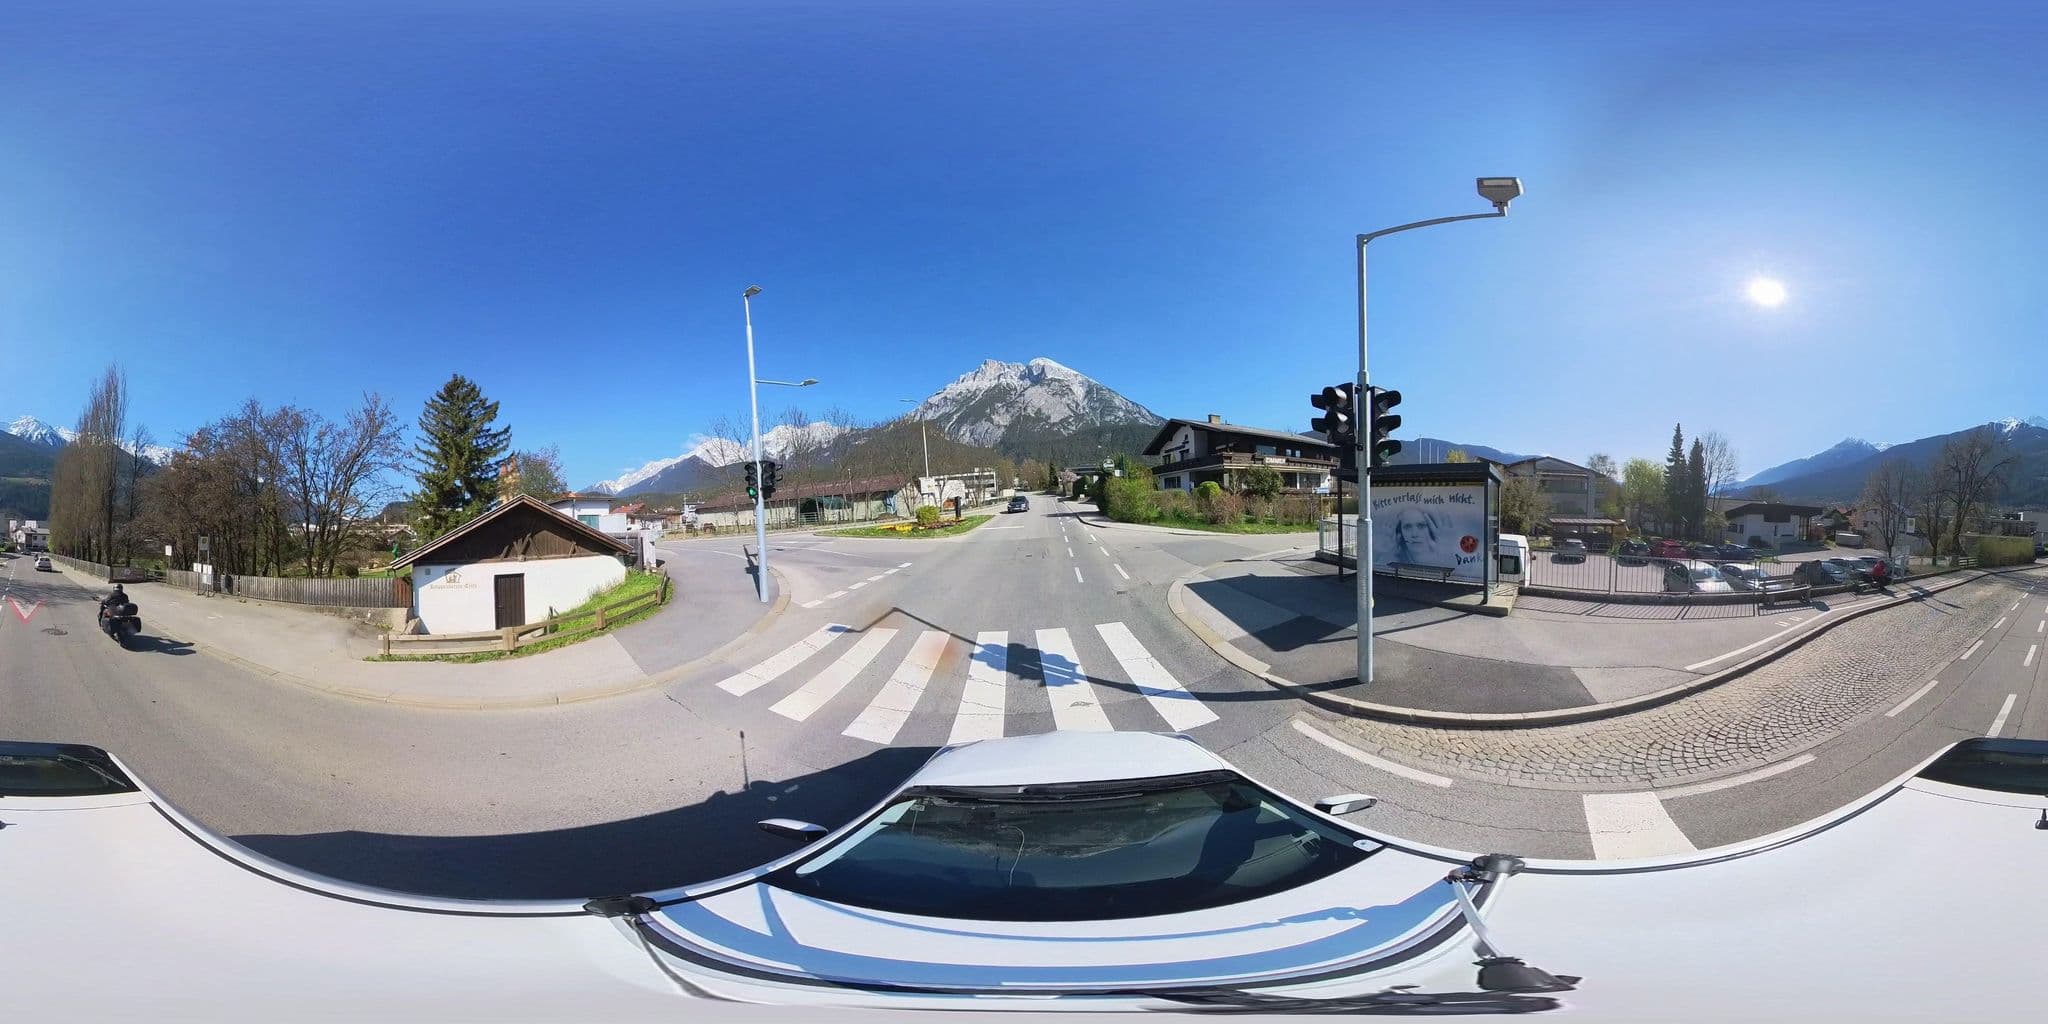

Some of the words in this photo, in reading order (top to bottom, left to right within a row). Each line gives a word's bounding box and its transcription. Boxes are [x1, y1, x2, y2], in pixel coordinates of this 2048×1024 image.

[1372, 498, 1392, 510] Bitte
[1424, 495, 1445, 504] mich
[1449, 493, 1475, 504] nicht.
